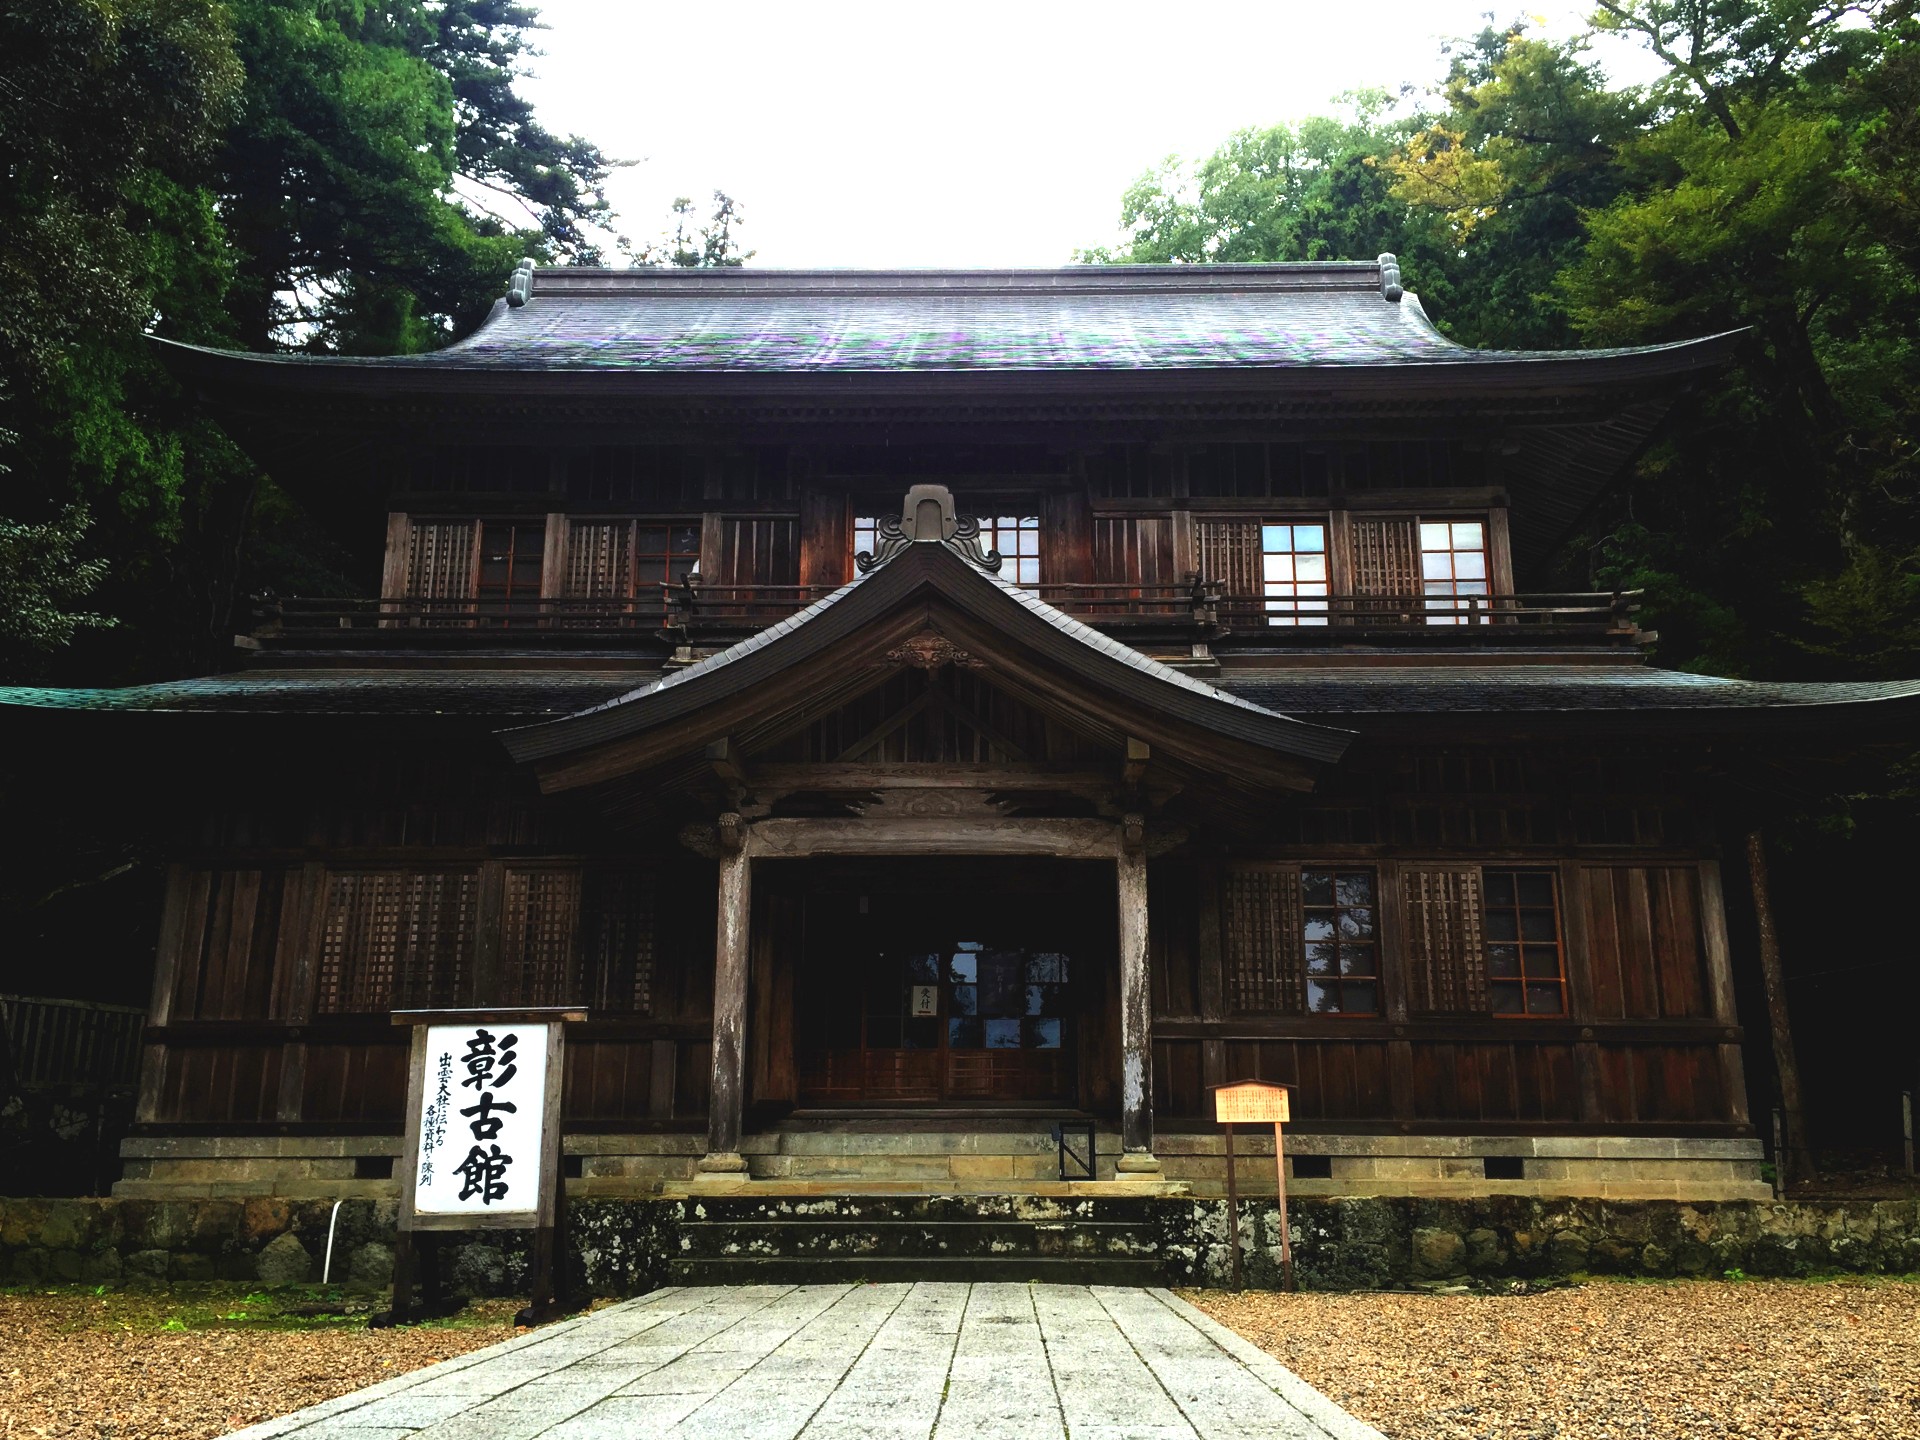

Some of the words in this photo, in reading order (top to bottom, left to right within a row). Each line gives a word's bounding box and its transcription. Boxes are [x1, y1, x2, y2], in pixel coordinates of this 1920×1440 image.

[435, 1052, 454, 1147] 出雲大社に伝わる
[452, 1029, 518, 1206] 彰古館
